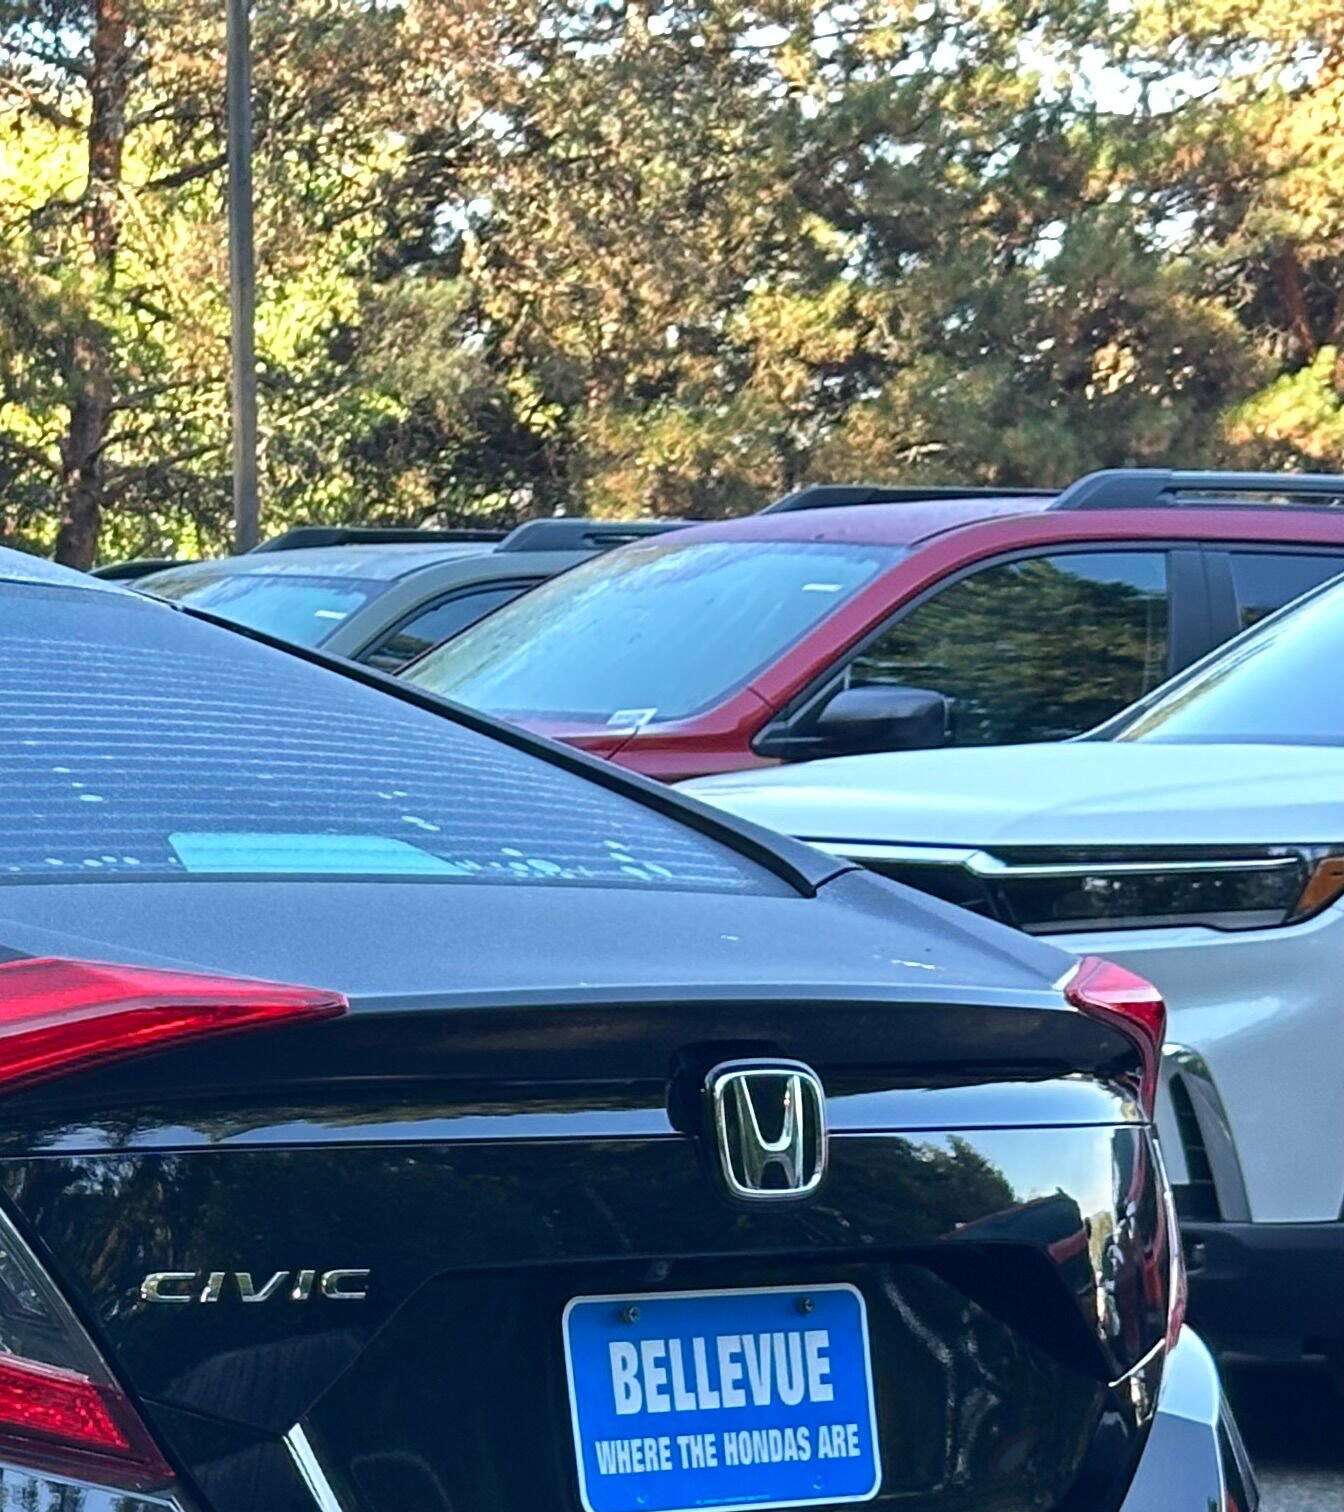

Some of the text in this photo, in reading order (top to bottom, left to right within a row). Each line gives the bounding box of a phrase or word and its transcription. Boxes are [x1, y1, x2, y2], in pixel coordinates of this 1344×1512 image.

[140, 1268, 371, 1303] CIVIC
[608, 1329, 834, 1416] BELLEVUE
[594, 1423, 861, 1475] WHERE THE HONDAS ARE
